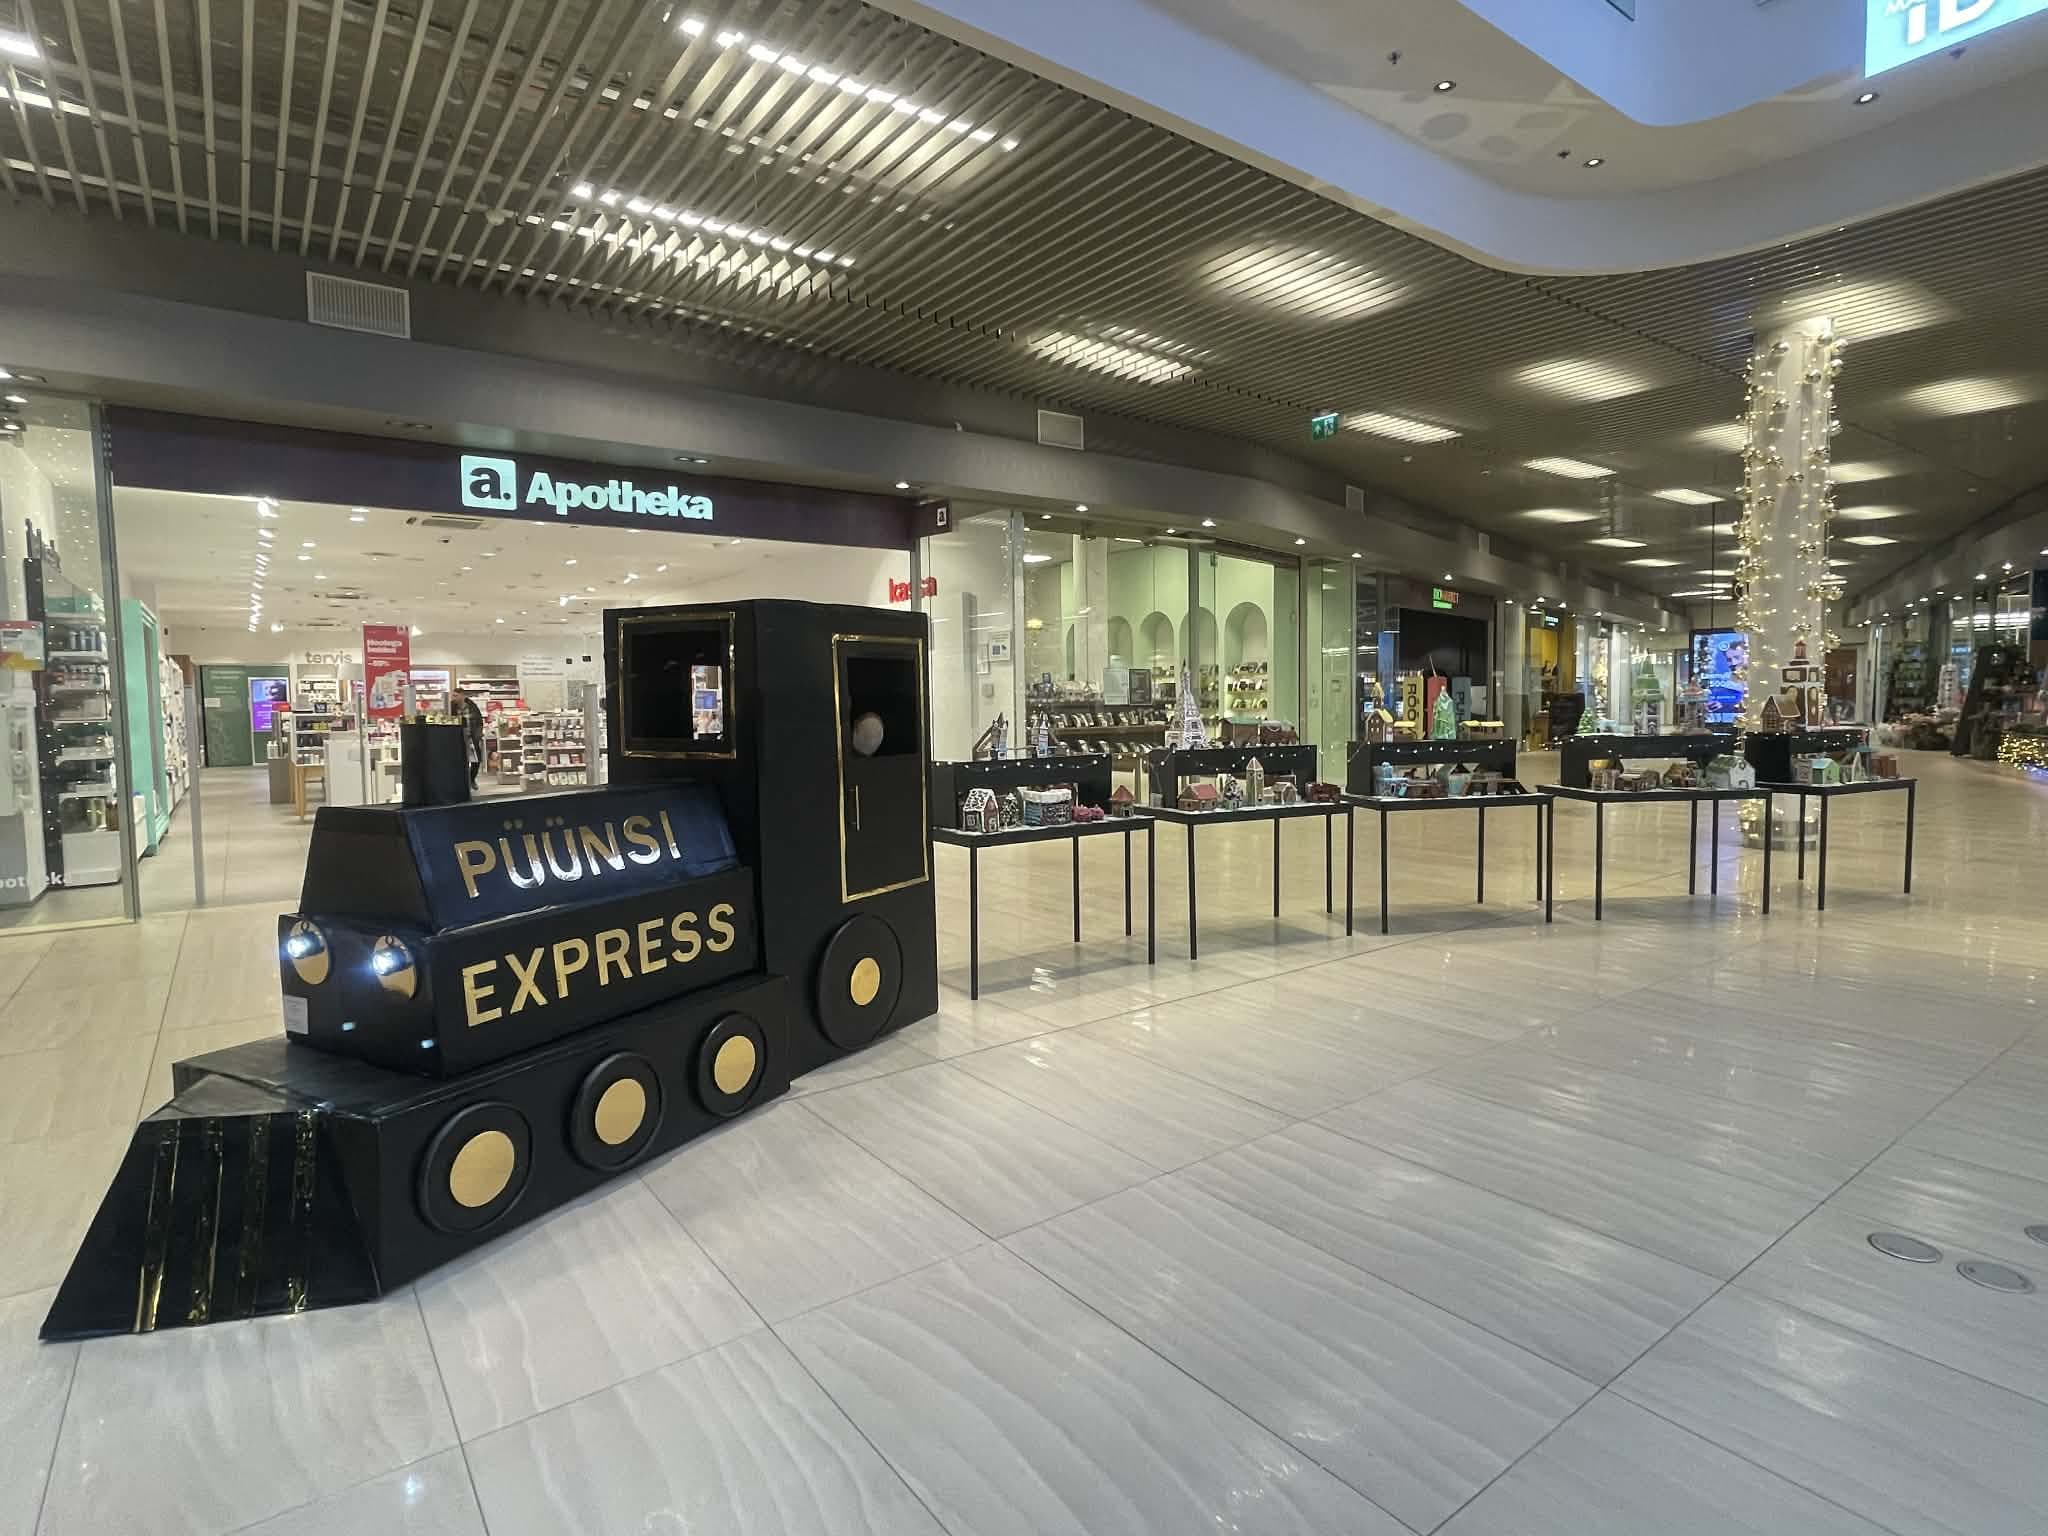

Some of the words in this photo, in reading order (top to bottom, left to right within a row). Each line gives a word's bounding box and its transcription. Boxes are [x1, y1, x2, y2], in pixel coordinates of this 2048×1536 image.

[525, 471, 714, 521] Apotheka
[305, 650, 353, 664] tervis
[454, 809, 682, 899] PÜÜNSI
[462, 903, 736, 1028] EXPRESS
